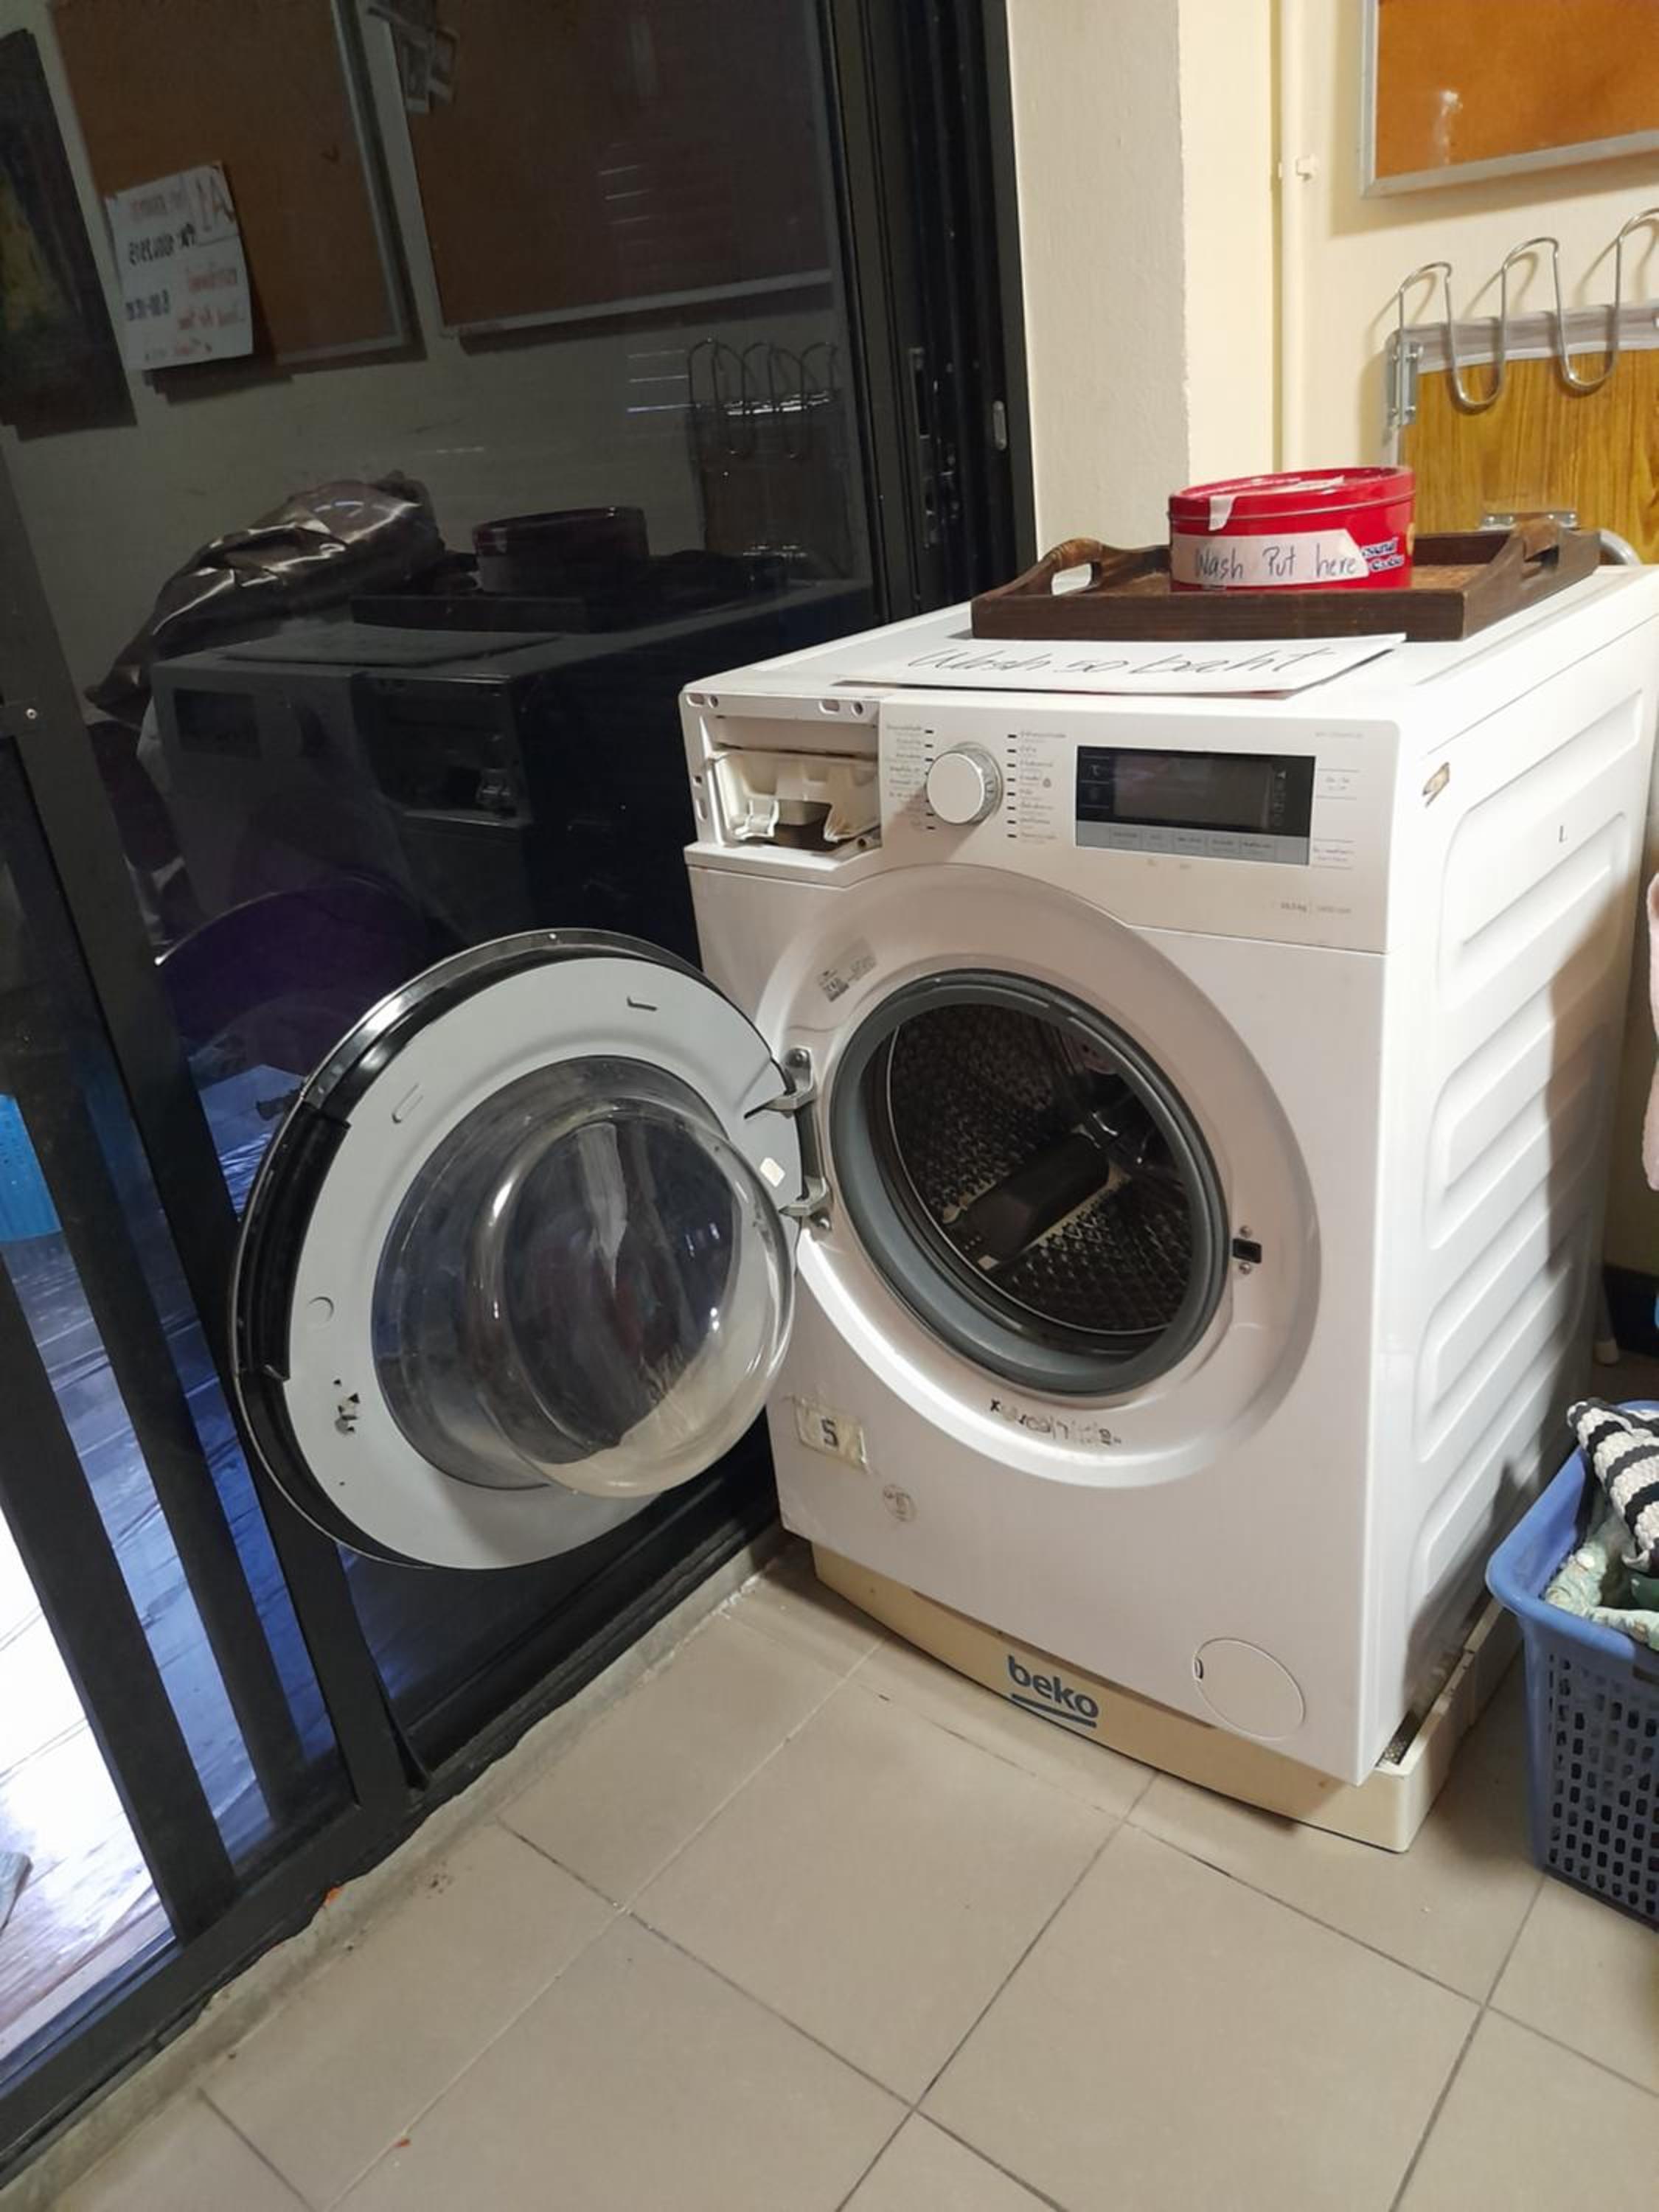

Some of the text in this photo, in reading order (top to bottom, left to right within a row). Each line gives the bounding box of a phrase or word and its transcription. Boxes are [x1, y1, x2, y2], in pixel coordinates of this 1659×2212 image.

[1195, 546, 1244, 579] Wash
[1262, 546, 1296, 577] Put
[1316, 543, 1356, 577] here
[1007, 1654, 1099, 1719] beko
